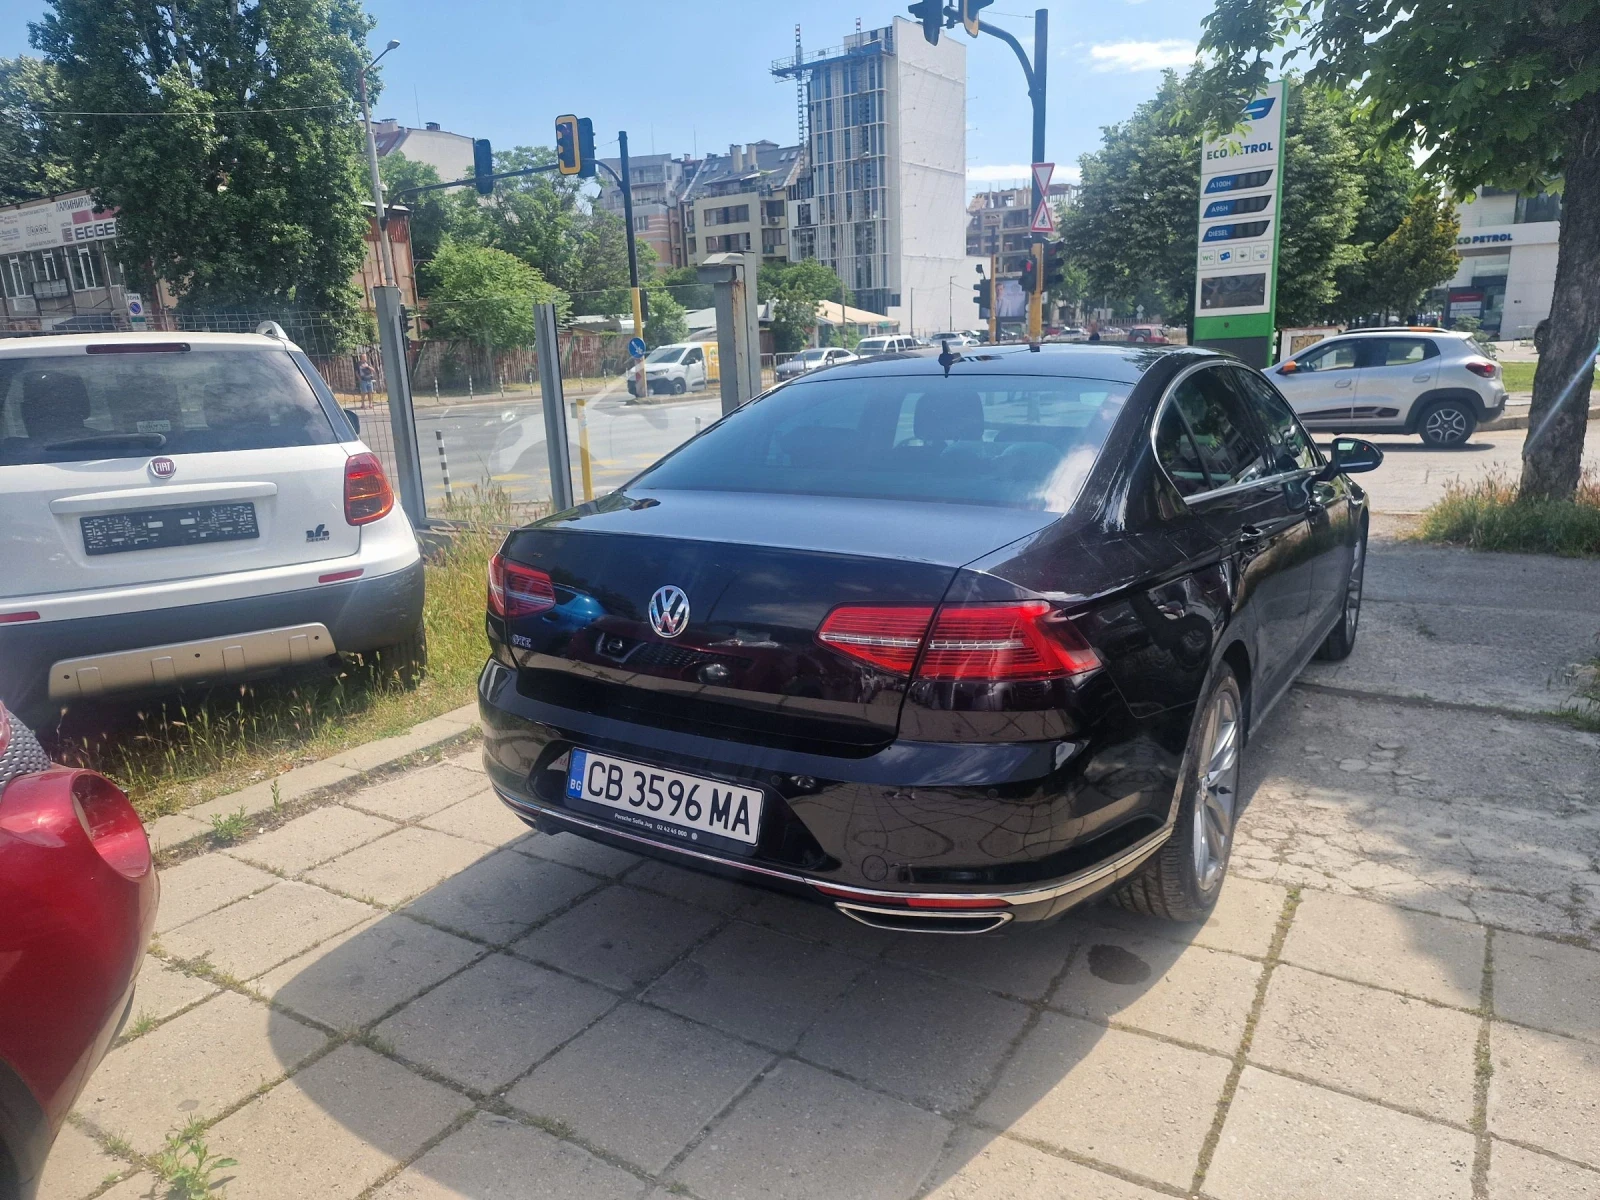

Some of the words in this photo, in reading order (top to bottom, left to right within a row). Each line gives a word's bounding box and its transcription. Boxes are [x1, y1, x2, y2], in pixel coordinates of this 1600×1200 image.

[1206, 148, 1228, 160] ECO
[1230, 142, 1274, 156] TROL
[1210, 180, 1231, 189] A100H
[1211, 205, 1229, 213] A95H
[1208, 229, 1228, 237] DIESEL
[1456, 236, 1472, 245] CO
[1472, 233, 1513, 244] PETROL
[155, 461, 171, 472] FIAT
[570, 778, 582, 791] BG
[587, 760, 624, 802] CB
[628, 770, 703, 822] 3596
[708, 787, 751, 836] MA
[614, 812, 632, 823] Porsche
[632, 816, 644, 826] Sofia
[644, 821, 653, 829] Jug
